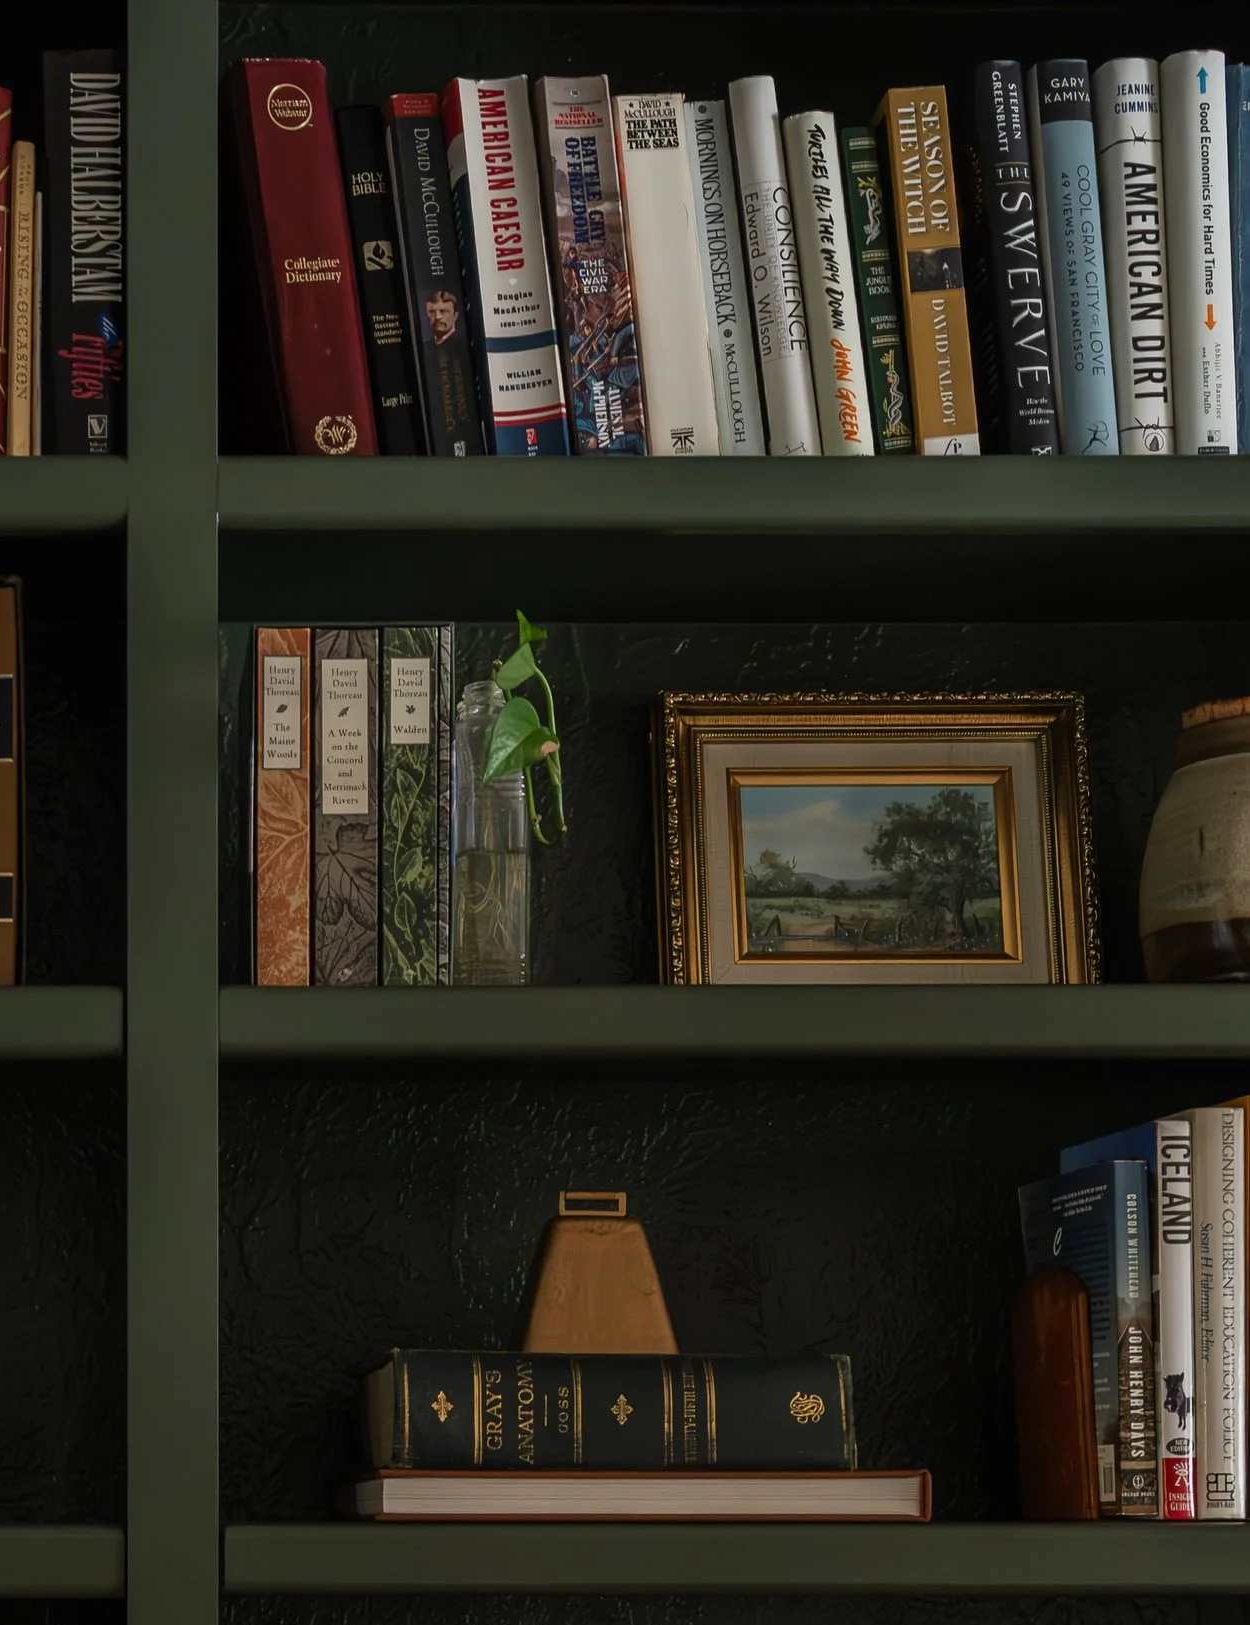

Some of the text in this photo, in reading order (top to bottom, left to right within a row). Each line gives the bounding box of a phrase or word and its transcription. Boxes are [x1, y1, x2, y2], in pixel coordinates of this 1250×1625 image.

[413, 128, 430, 171] DAVID
[625, 119, 676, 129] THE PATH
[627, 130, 677, 138] BETWEEN
[627, 139, 679, 150] THE SEAS
[992, 71, 1008, 152] GREENBLATT
[1008, 83, 1022, 139] STEPHEN
[70, 72, 122, 303] DAVID HALBERSTAM
[478, 89, 525, 271] AMERICAN CAESAR
[565, 137, 589, 244] OF FREEDOM
[580, 136, 605, 241] BATTLE CRY
[896, 102, 925, 234] THE WITCH
[920, 101, 949, 232] SEASON OF
[1199, 102, 1215, 295] Good Economics for Hard Times
[693, 119, 736, 326] MORNINGS ON HORSEBACK
[772, 187, 807, 351] CONSILIENCE
[285, 272, 341, 283] Dictionary
[744, 193, 773, 356] Edward O. Wilson
[999, 192, 1050, 387] SWERVE
[1123, 162, 1168, 404] AMERICAN DIRT
[393, 689, 427, 698] Thoreau
[397, 667, 424, 678] Henry
[397, 678, 423, 687] David
[266, 750, 298, 759] Woods
[269, 737, 296, 746] Maine
[274, 723, 290, 732] The
[394, 725, 427, 734] Walden
[1161, 1135, 1191, 1245] ICELAND
[486, 1370, 502, 1451] GRAY'S
[519, 1359, 535, 1465] ANATOMY
[1129, 1327, 1145, 1458] JOHN HENRY DAYS
